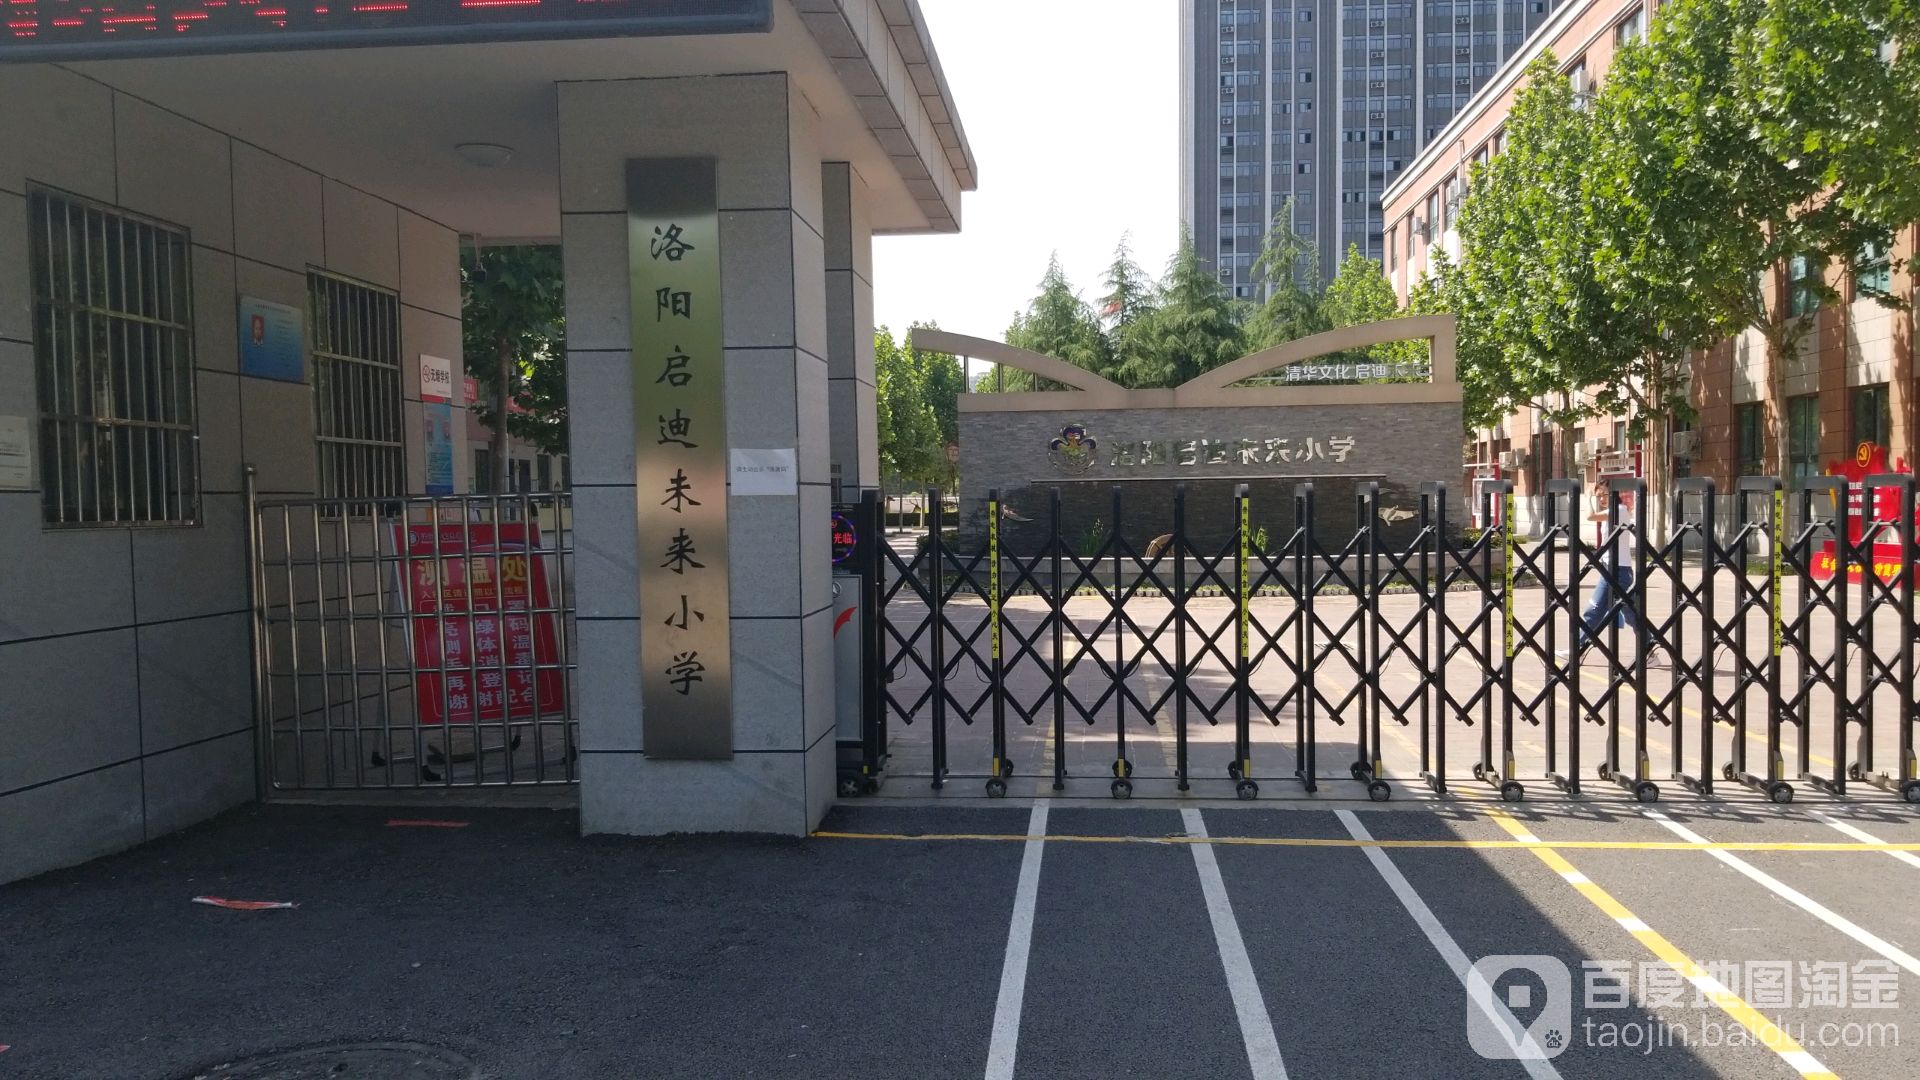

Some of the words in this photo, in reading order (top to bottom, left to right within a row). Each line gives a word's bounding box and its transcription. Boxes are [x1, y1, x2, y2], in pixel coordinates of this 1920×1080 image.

[649, 223, 705, 695] 洛阳启迪未来小学
[1285, 365, 1350, 381] 清华文化
